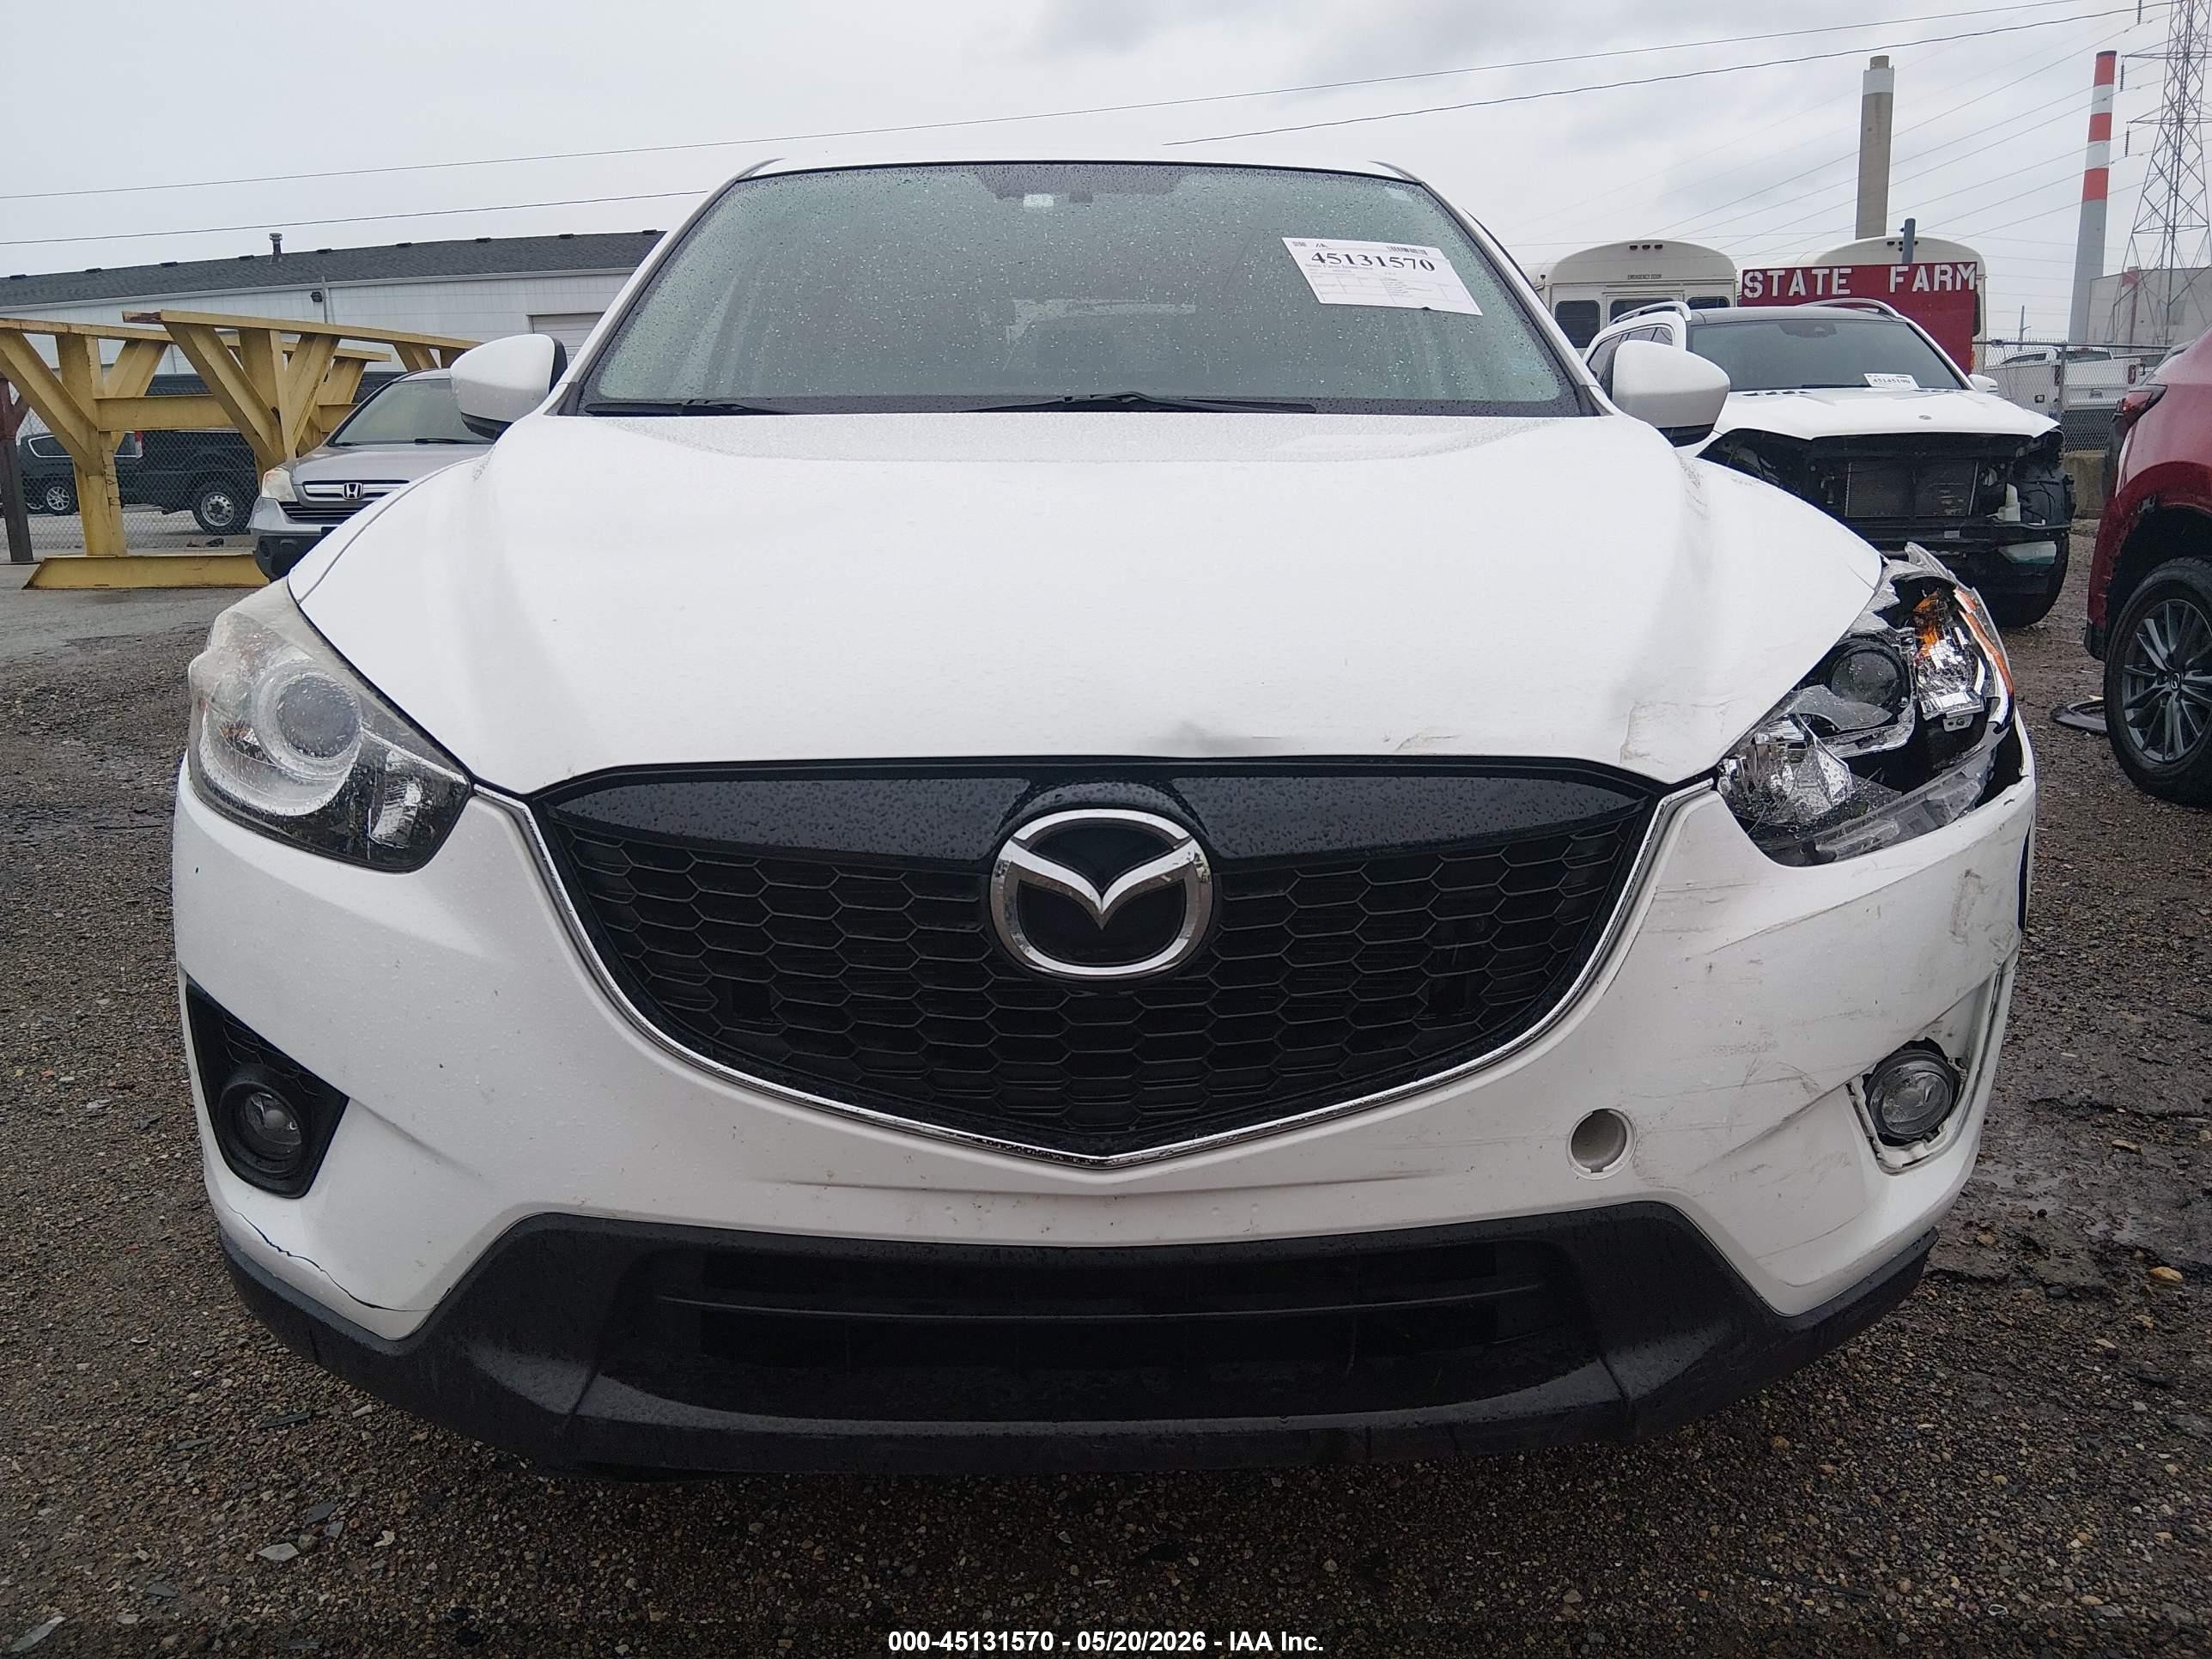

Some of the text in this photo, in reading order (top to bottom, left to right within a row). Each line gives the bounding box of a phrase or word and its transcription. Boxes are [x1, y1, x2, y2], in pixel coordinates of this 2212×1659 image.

[1311, 252, 1436, 272] 45131570
[1743, 263, 1976, 298] STATE FARM
